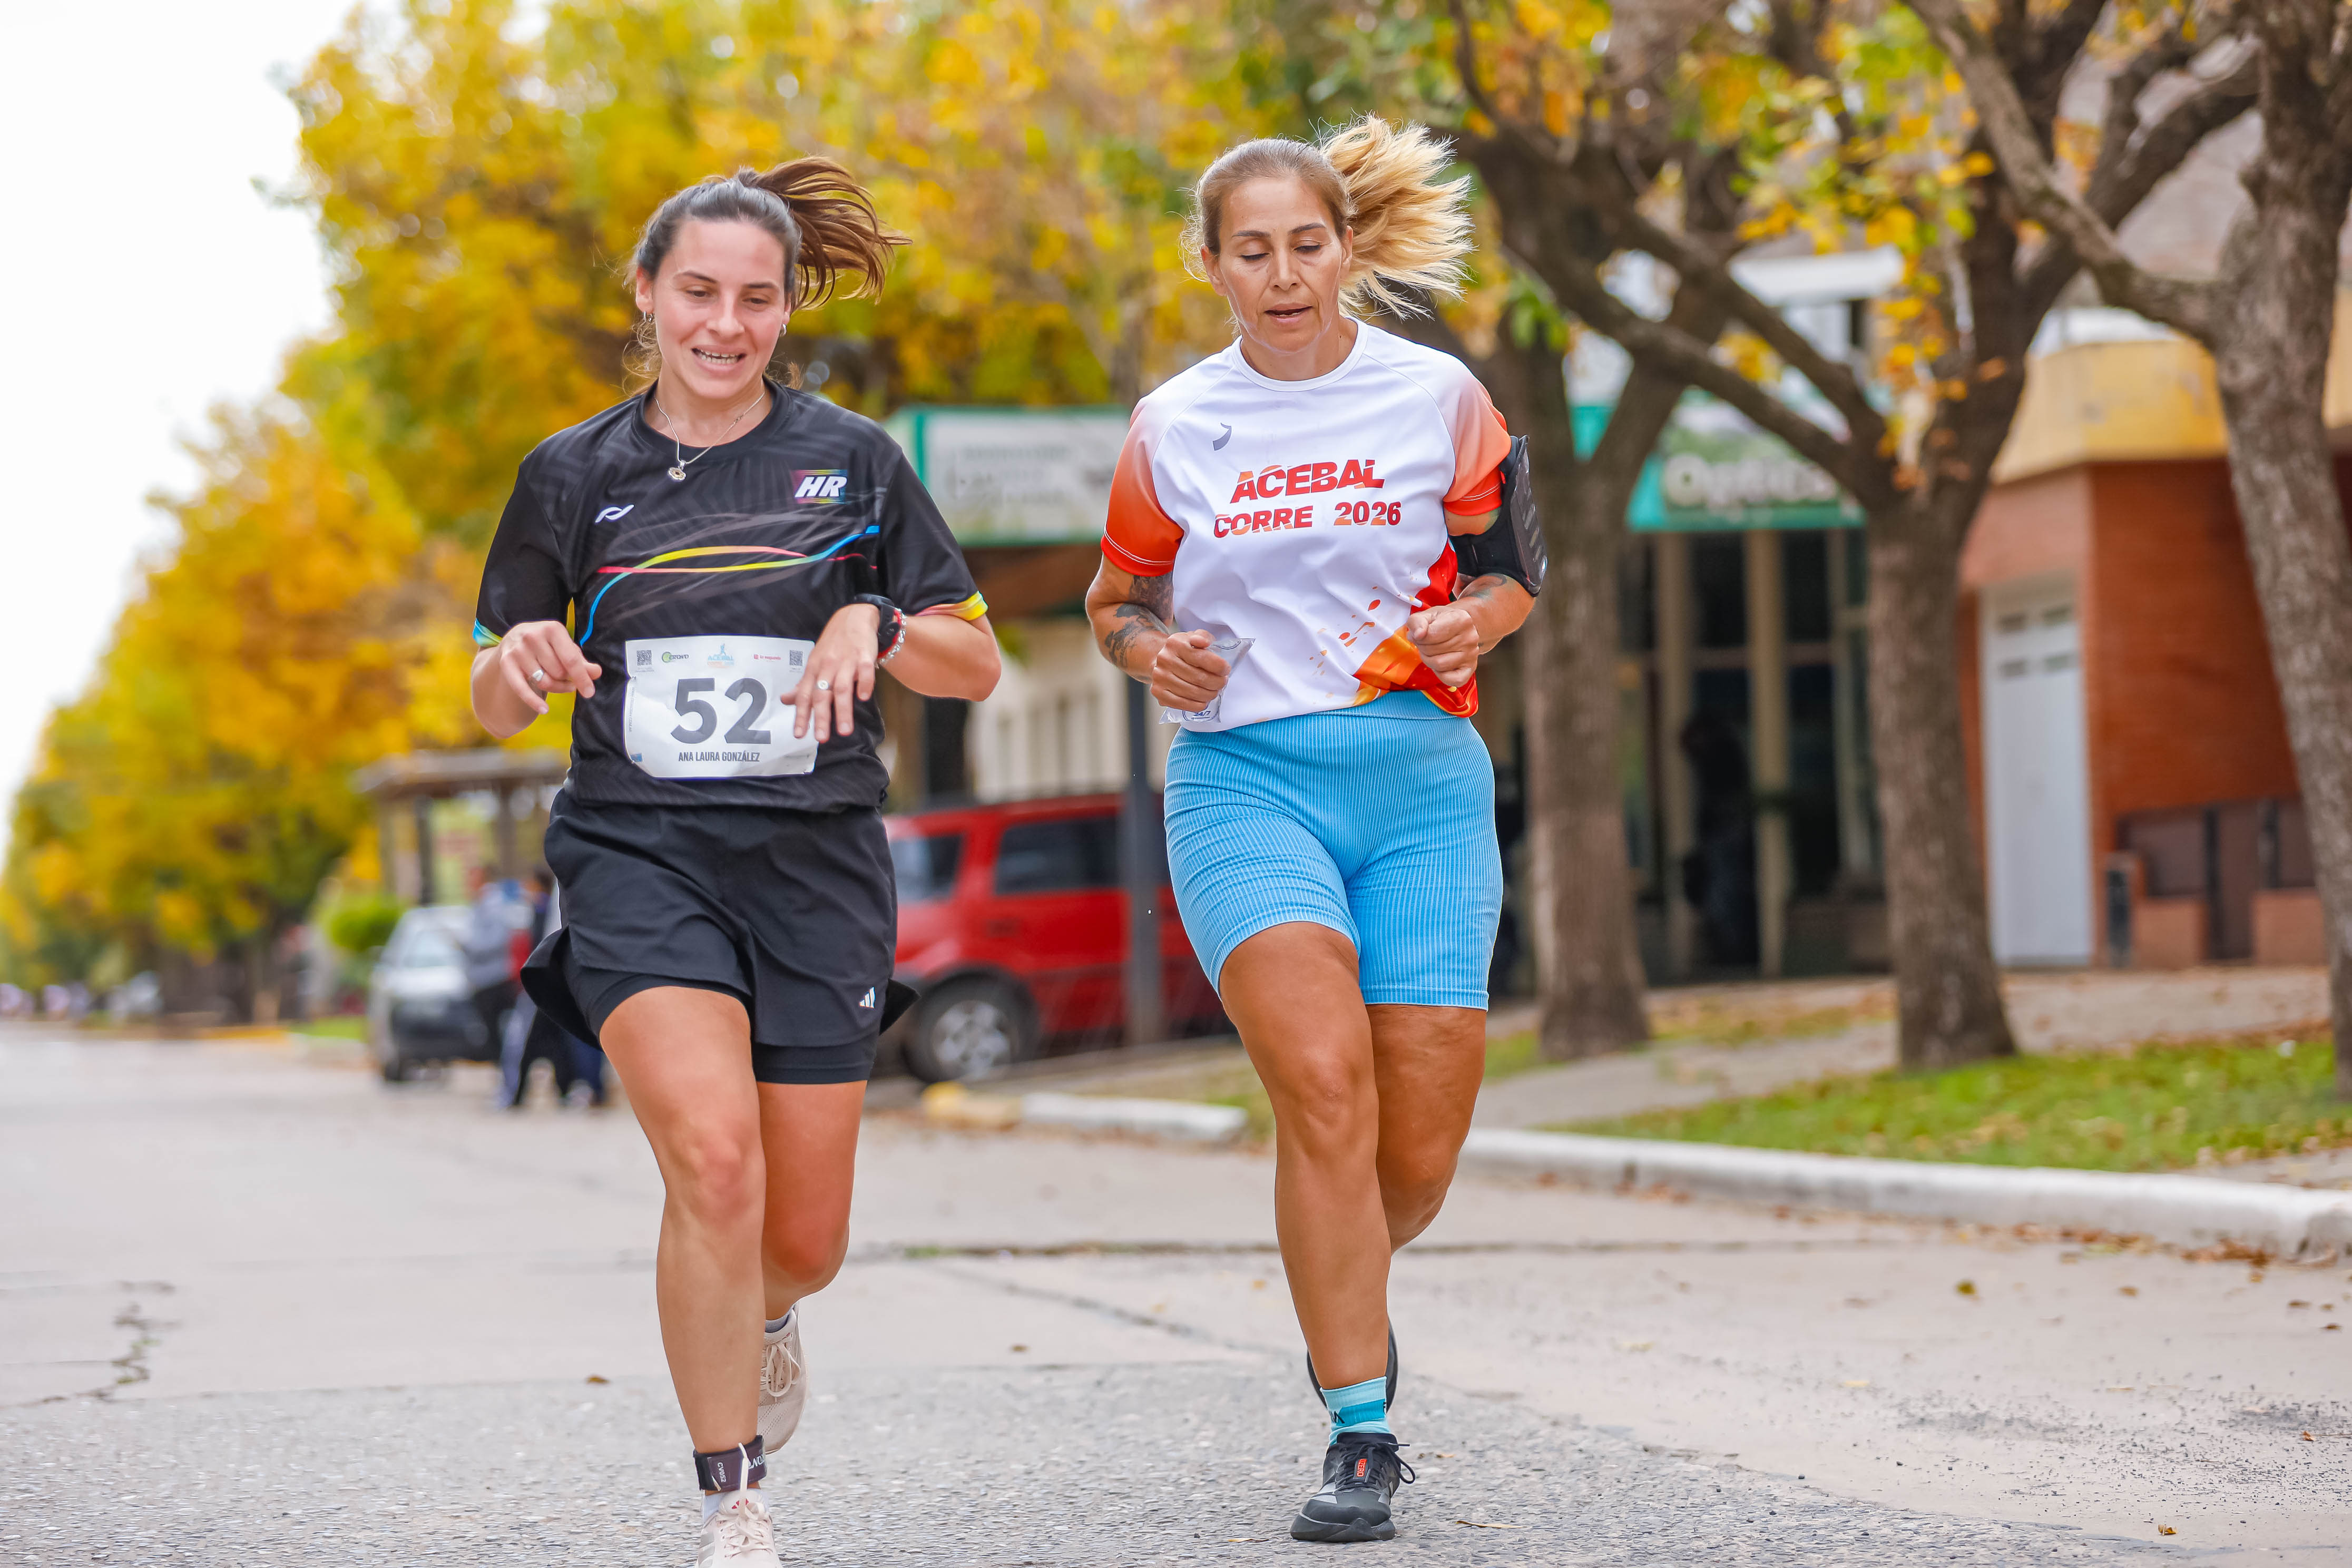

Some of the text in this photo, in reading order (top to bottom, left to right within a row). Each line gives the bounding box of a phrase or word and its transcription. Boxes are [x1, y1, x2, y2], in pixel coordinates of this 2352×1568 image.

[795, 476, 847, 498] HR
[1230, 459, 1385, 504] ACEBAL
[1213, 501, 1402, 538] CORRE 2026
[670, 677, 771, 744] 52
[678, 750, 760, 762] ANA LAURA GONZÁLEZ
[717, 1462, 727, 1483] CV052
